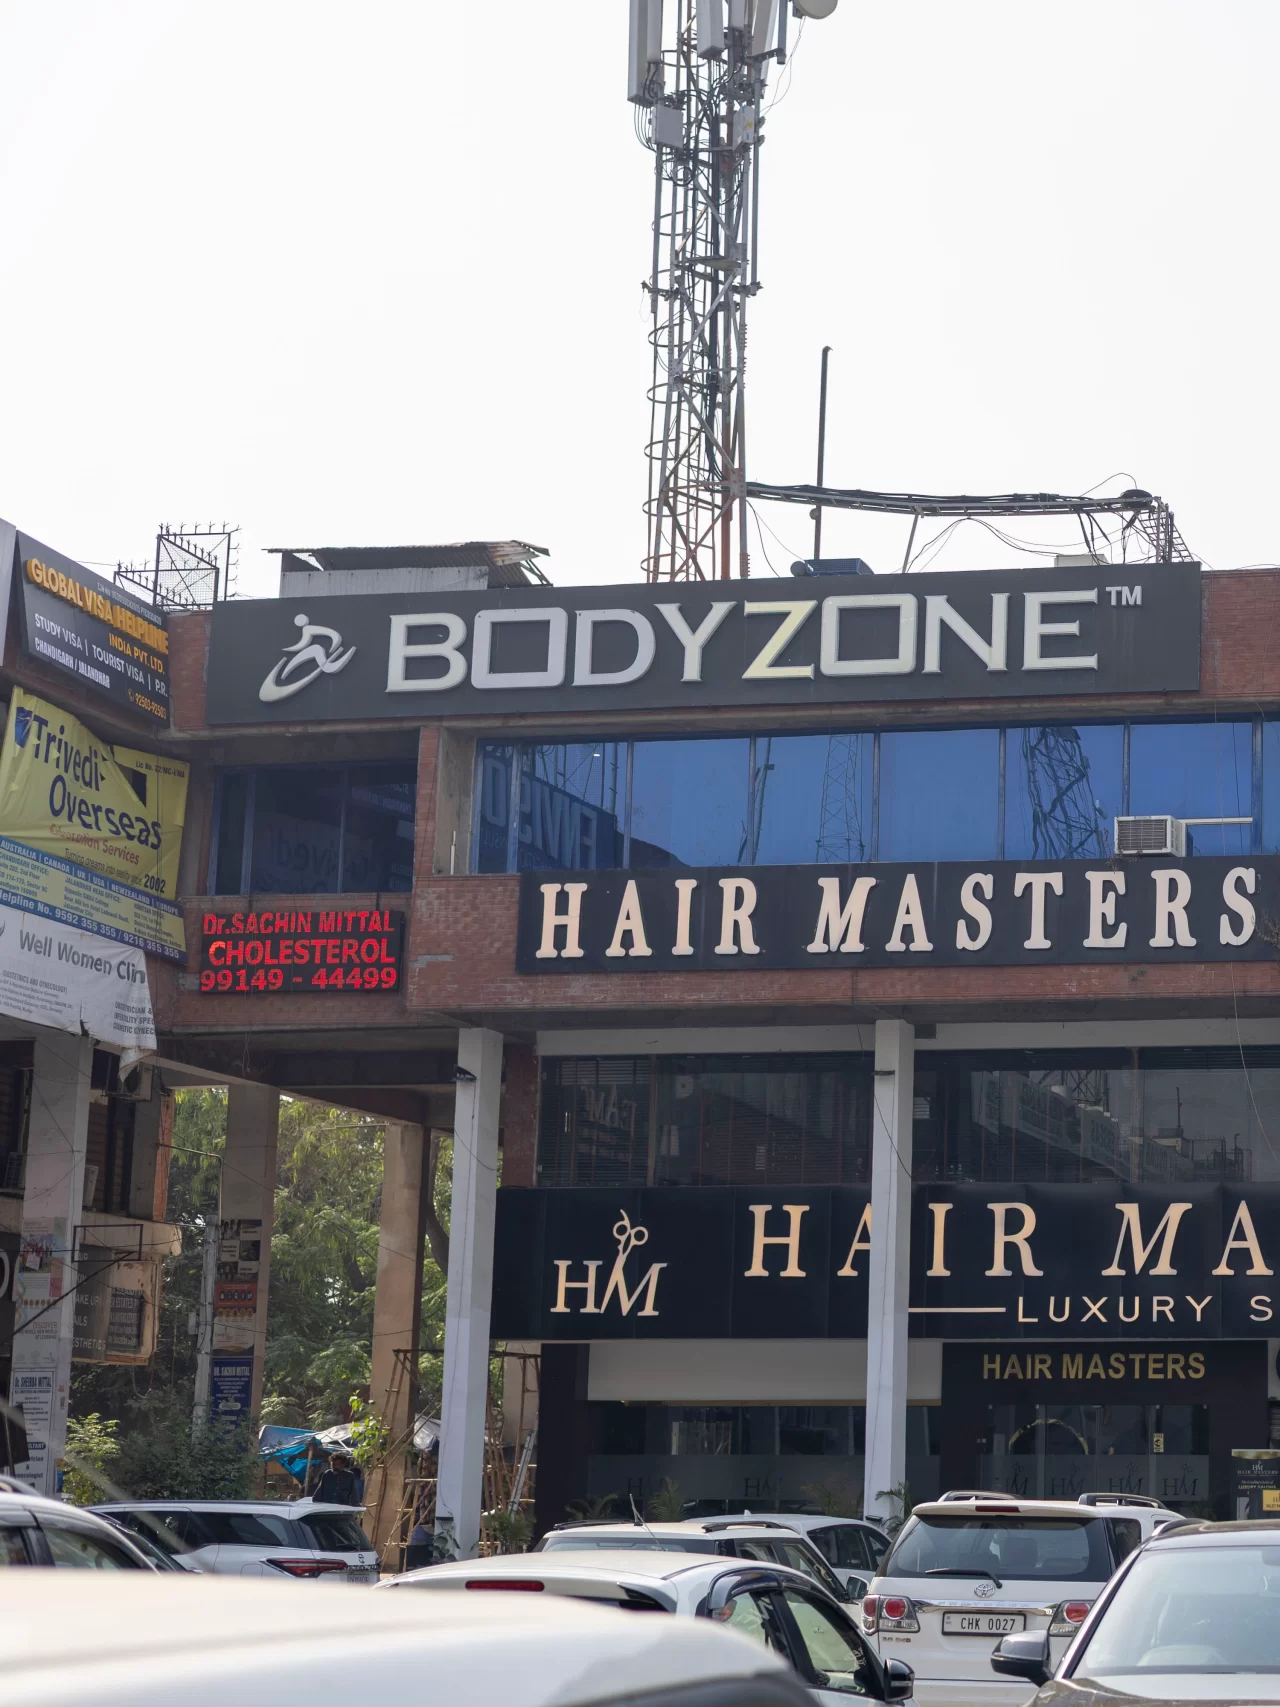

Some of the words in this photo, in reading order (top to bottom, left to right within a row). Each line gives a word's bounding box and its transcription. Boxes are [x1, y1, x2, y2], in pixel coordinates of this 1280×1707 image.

[28, 558, 83, 607] GLOBAL
[82, 586, 113, 624] VISA
[113, 604, 168, 655] HELPLINE
[35, 613, 61, 639] STUDY
[62, 627, 82, 650] VISA
[92, 645, 124, 673] TOURIST
[126, 662, 144, 684] VISA
[109, 633, 132, 657] INDIA
[150, 655, 165, 674] LTD.
[385, 586, 1099, 693] BODYZONE
[35, 637, 74, 669] CHANDIGARH
[79, 660, 110, 689] JALANDHAR
[33, 714, 100, 791] Trivedi
[49, 774, 161, 850] Overseas
[102, 840, 140, 865] Services
[1, 840, 37, 860] AUSTRALIA
[44, 856, 70, 874] CANADA
[77, 870, 86, 880] UK
[93, 877, 105, 888] USA
[155, 901, 179, 915] EUROPE
[144, 874, 166, 893] 2002
[37, 901, 52, 915] No.
[55, 908, 78, 924] 9592
[81, 918, 98, 932] 355
[100, 924, 116, 938] 355
[124, 933, 144, 947] 9216
[147, 940, 162, 952] 355
[164, 946, 179, 959] 355
[319, 911, 395, 933] MITTAL
[535, 877, 760, 959] HAIR
[806, 867, 1258, 954] MASTERS
[20, 929, 52, 958] Well
[58, 941, 112, 975] Women
[209, 938, 395, 966] CHOLESTEROL
[200, 968, 284, 991] 99149
[311, 967, 397, 990] 44499
[76, 1295, 89, 1305] AKE
[1018, 1296, 1212, 1323] LUXURY
[74, 1316, 88, 1326] AILS
[73, 1337, 106, 1350] ESTHETICS
[983, 1354, 1052, 1380] HAIR
[1061, 1352, 1206, 1380] MASTERS
[961, 1617, 980, 1630] CHK
[988, 1618, 1016, 1631] 0027
